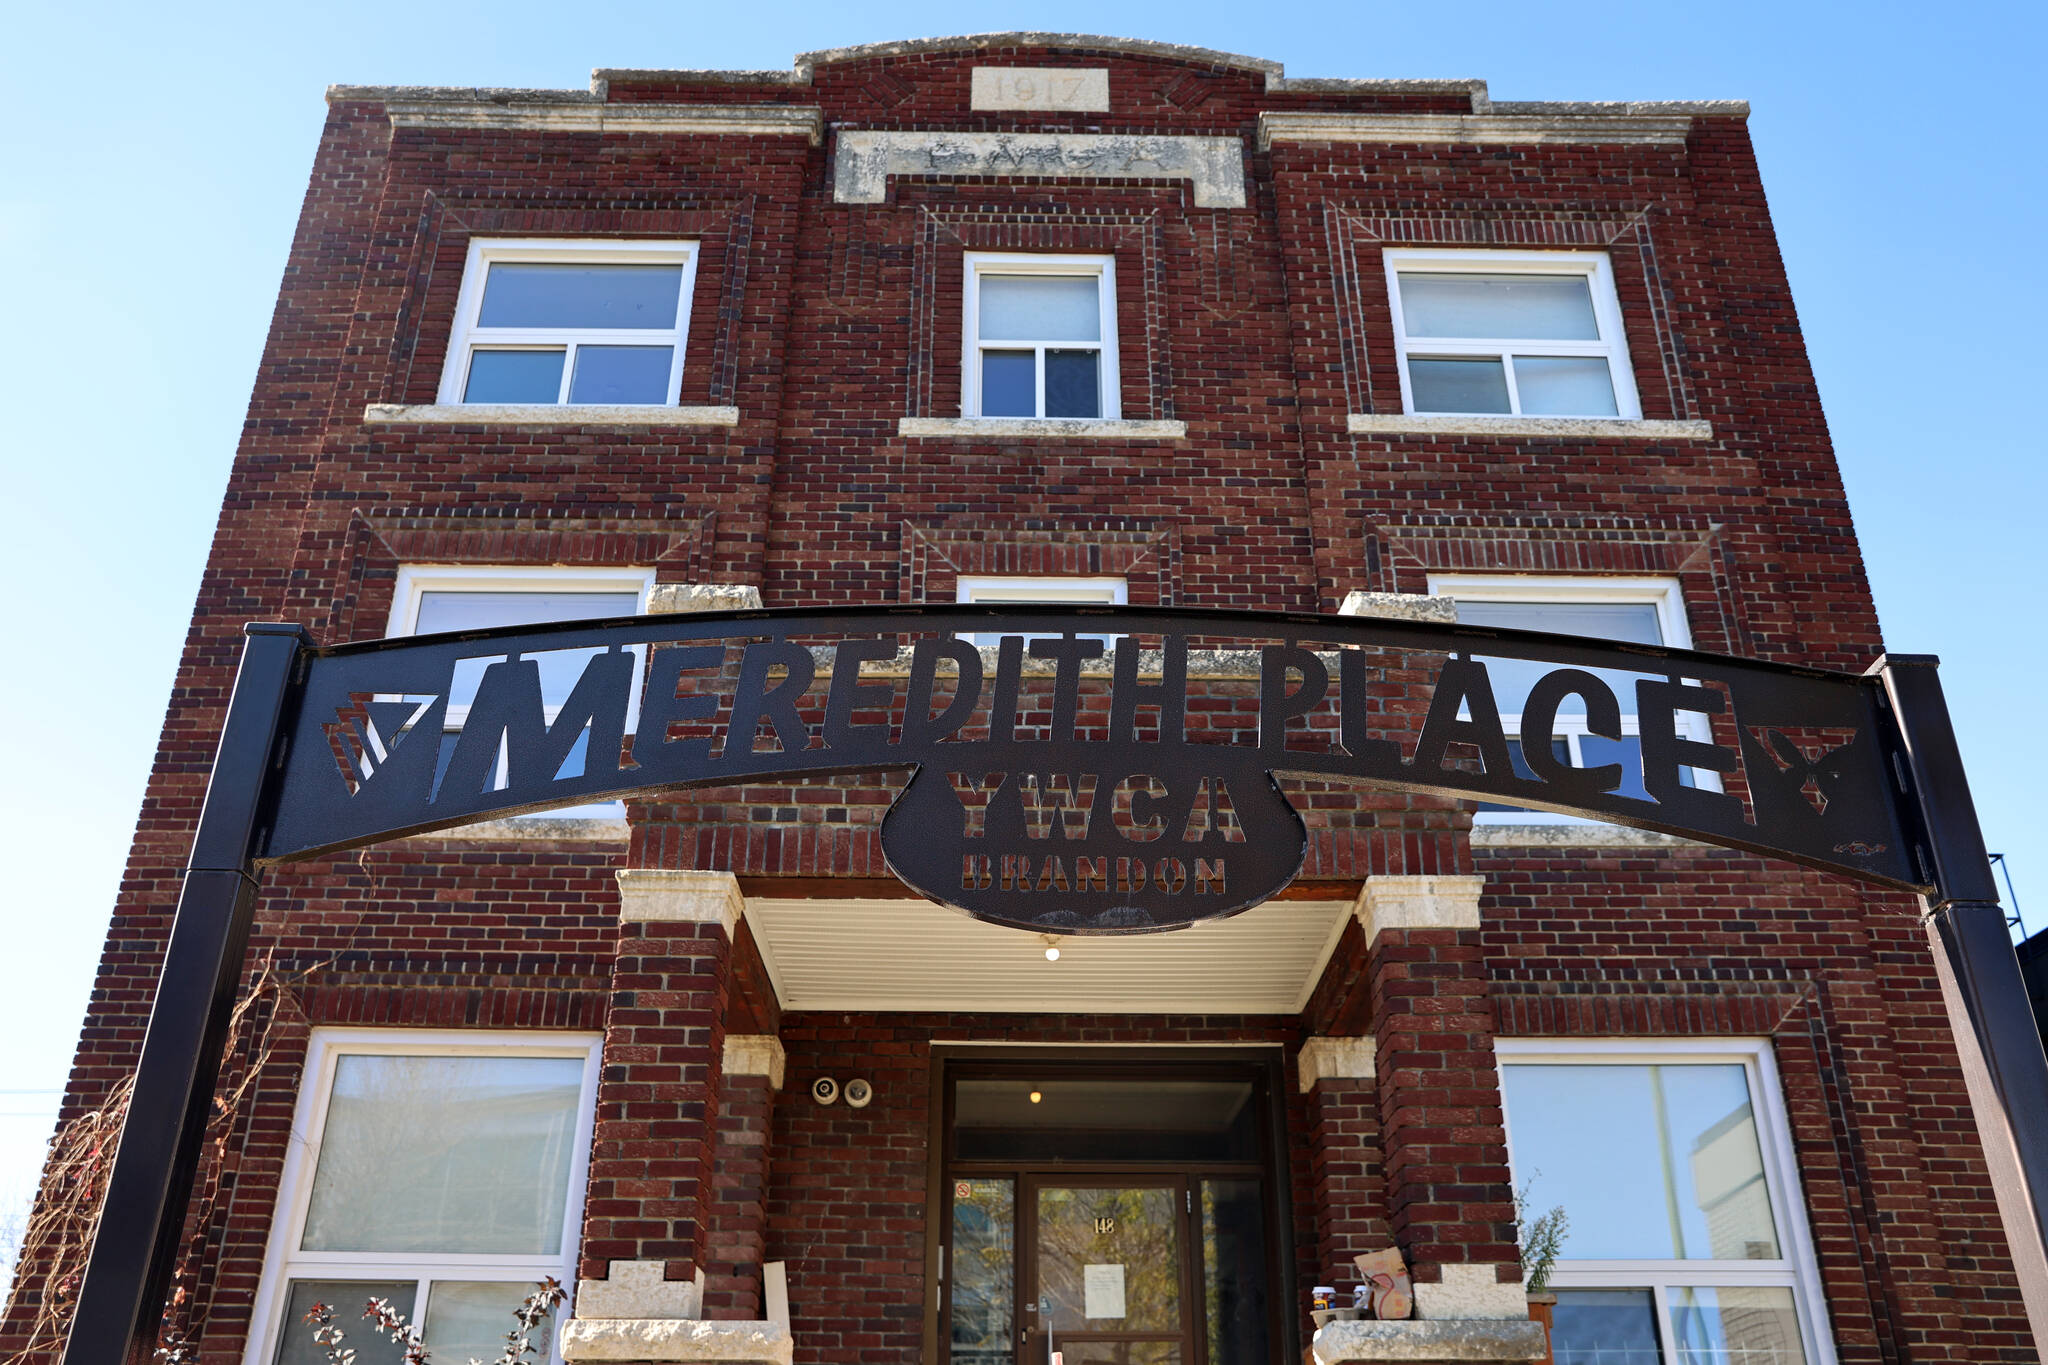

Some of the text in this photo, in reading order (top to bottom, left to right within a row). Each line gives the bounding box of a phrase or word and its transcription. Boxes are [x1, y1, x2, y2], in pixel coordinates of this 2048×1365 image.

[432, 636, 1745, 824] MEREDITH PLACE
[946, 773, 1247, 843] YWCA
[960, 855, 1226, 895] BRANDON
[1094, 1217, 1115, 1235] 148
